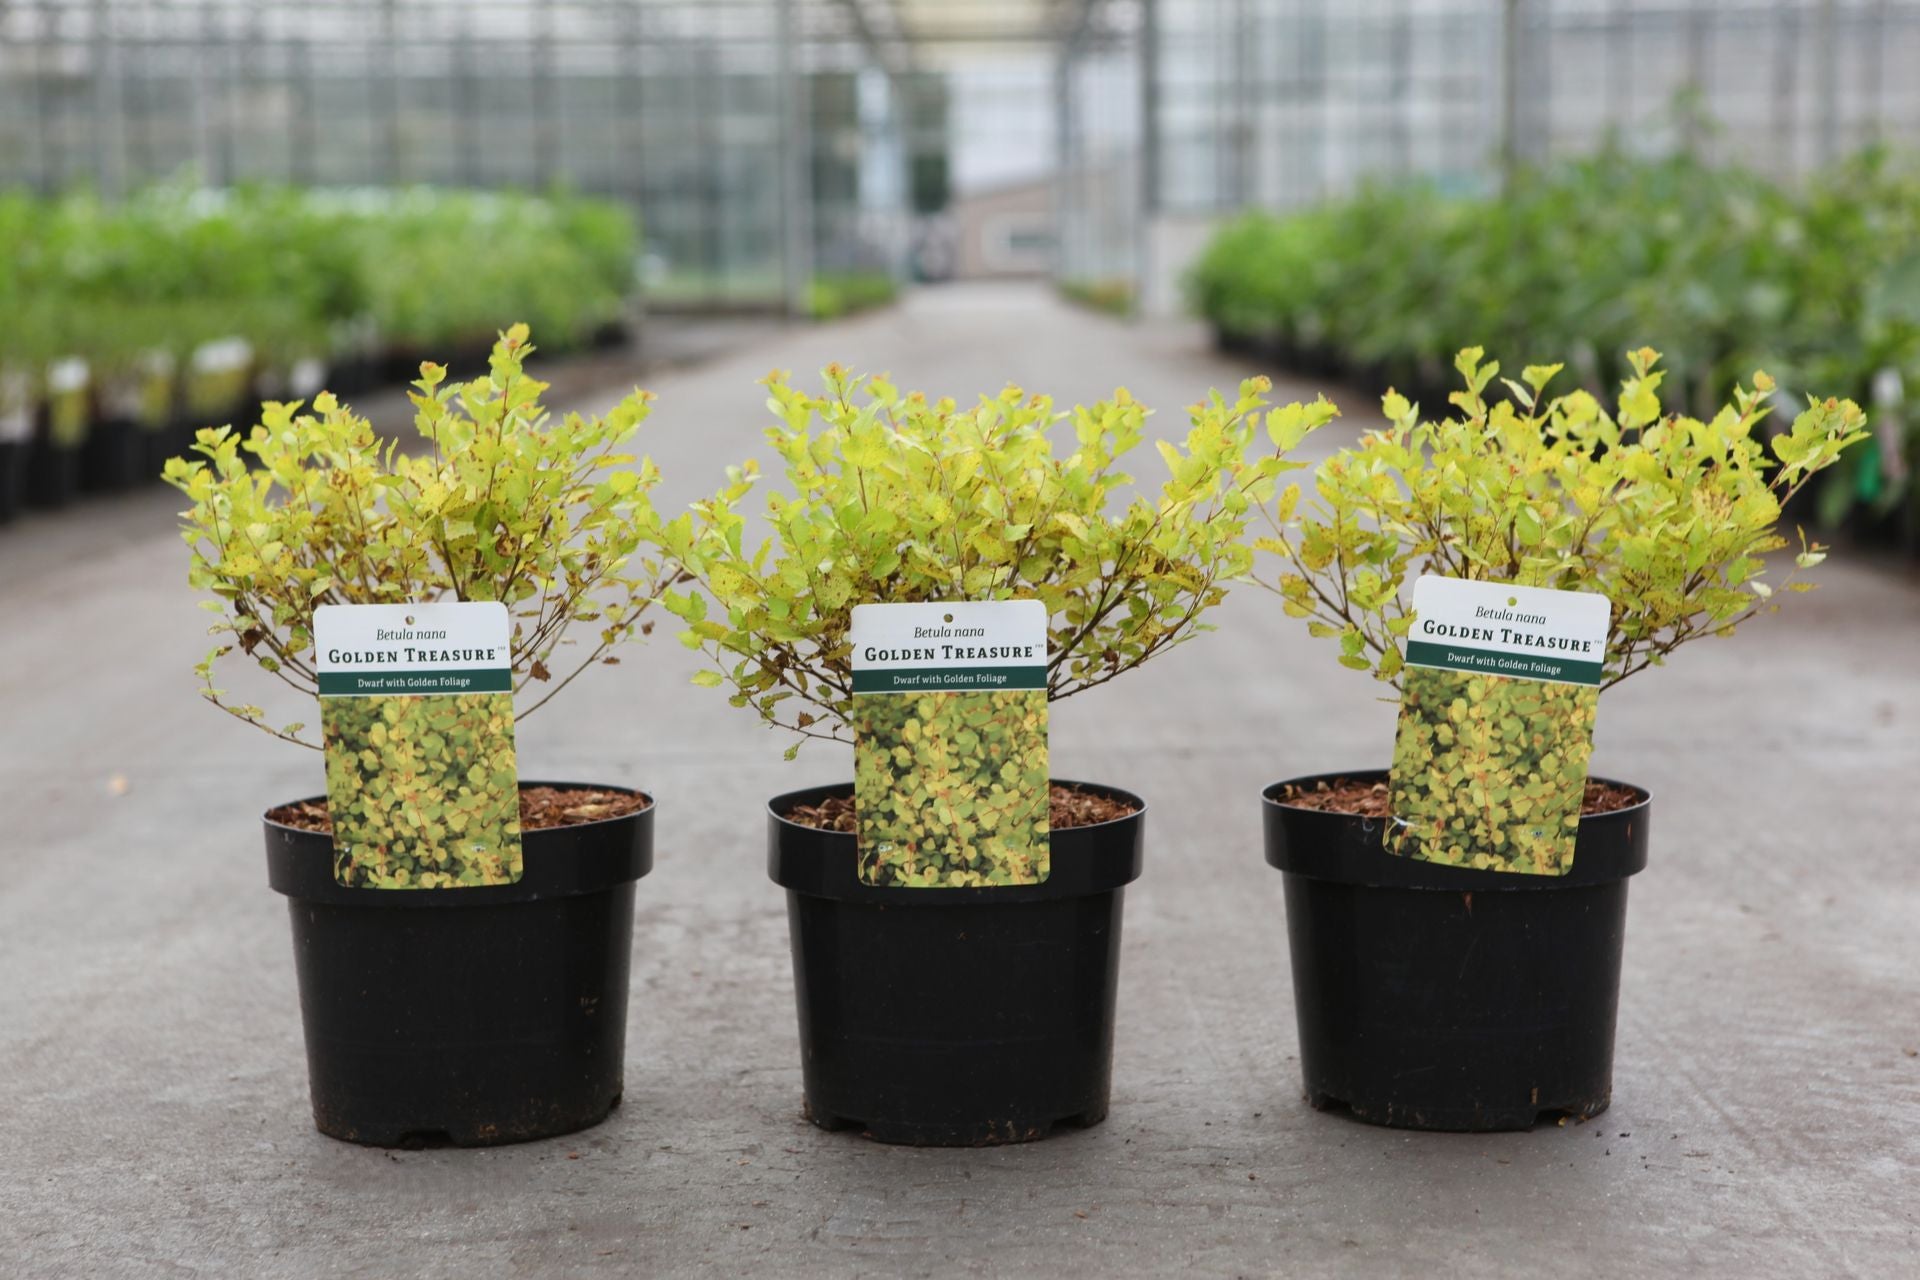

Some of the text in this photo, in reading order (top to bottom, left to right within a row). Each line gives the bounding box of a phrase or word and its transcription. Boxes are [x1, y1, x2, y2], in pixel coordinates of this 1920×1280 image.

[1475, 606, 1546, 625] Betula nana
[376, 628, 447, 641] Betula nana
[914, 626, 985, 639] Betula nana
[1423, 619, 1591, 653] GOLDEN TREASURE
[328, 647, 496, 664] GOLDEN TREASURE
[864, 647, 935, 661] GOLDEN
[941, 645, 1033, 659] TREASURE
[1447, 652, 1561, 675] Dwarf with Golden Foliage
[357, 676, 471, 688] Dwarf with Golden Foliage
[893, 674, 1007, 685] Dwarf with Golden Foliage
